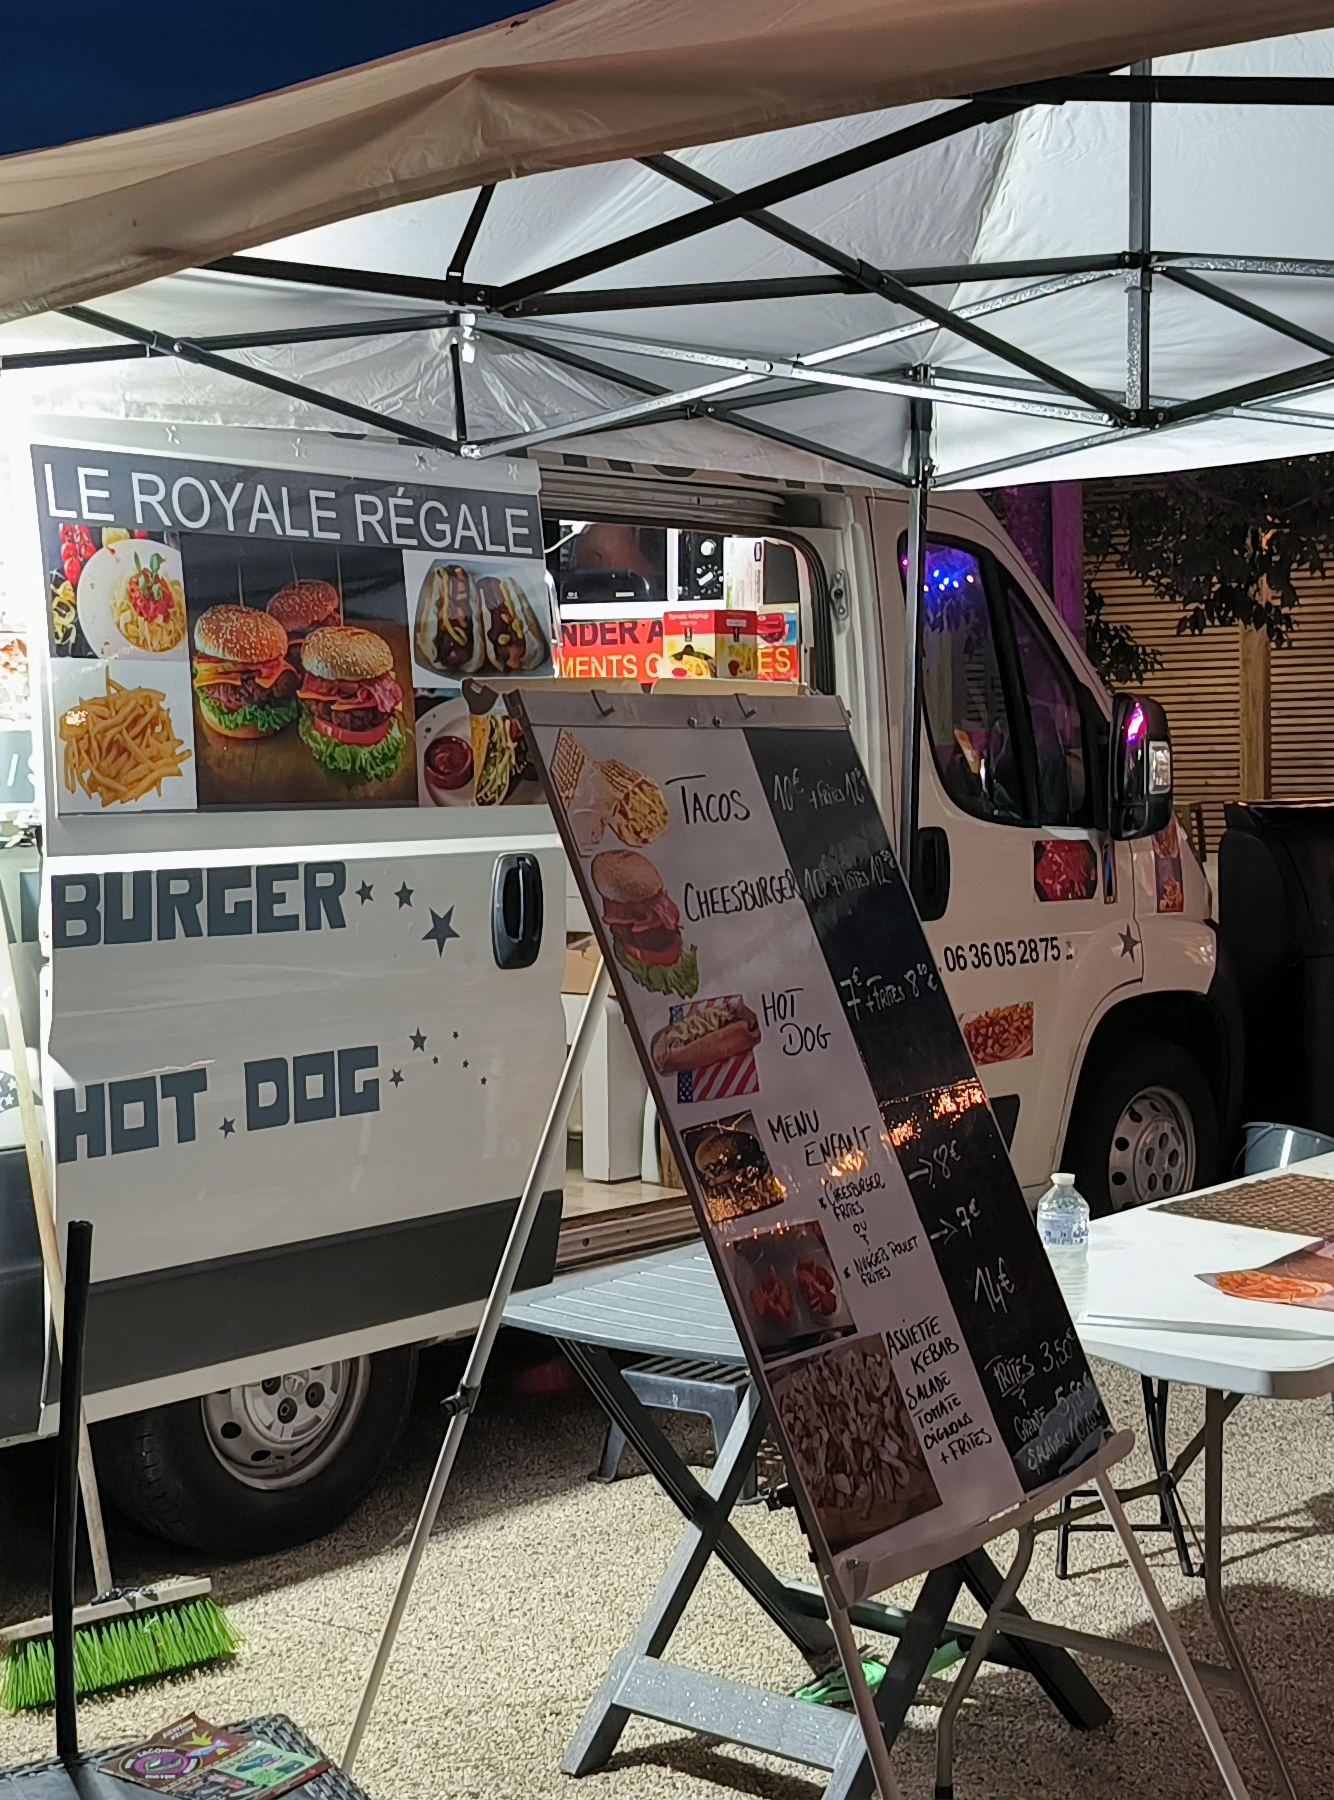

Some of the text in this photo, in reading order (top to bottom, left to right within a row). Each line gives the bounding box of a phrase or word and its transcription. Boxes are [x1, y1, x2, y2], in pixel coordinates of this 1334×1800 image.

[42, 462, 534, 556] LE ROYALE RÉGALE
[560, 620, 640, 648] NDER
[558, 652, 638, 679] MENTS
[665, 773, 752, 826] TACOS
[51, 861, 347, 949] BURGER
[682, 867, 799, 924] CHEESBURGER
[944, 936, 1061, 972] 06 36 05 28 75
[762, 986, 804, 1028] HOT
[781, 1022, 832, 1057] DOG
[55, 1045, 380, 1164] HOT DOG
[767, 1109, 820, 1144] MENU
[804, 1126, 872, 1168] ENFANT
[832, 1200, 865, 1222] FRITES
[852, 1220, 868, 1234] OU
[860, 1265, 892, 1288] FRITES
[973, 1256, 1016, 1314] 14€
[885, 1316, 942, 1360] ASSIETTE
[910, 1336, 960, 1376] KEBAB
[905, 1370, 952, 1411] SALADE
[913, 1392, 962, 1429] TOMATE
